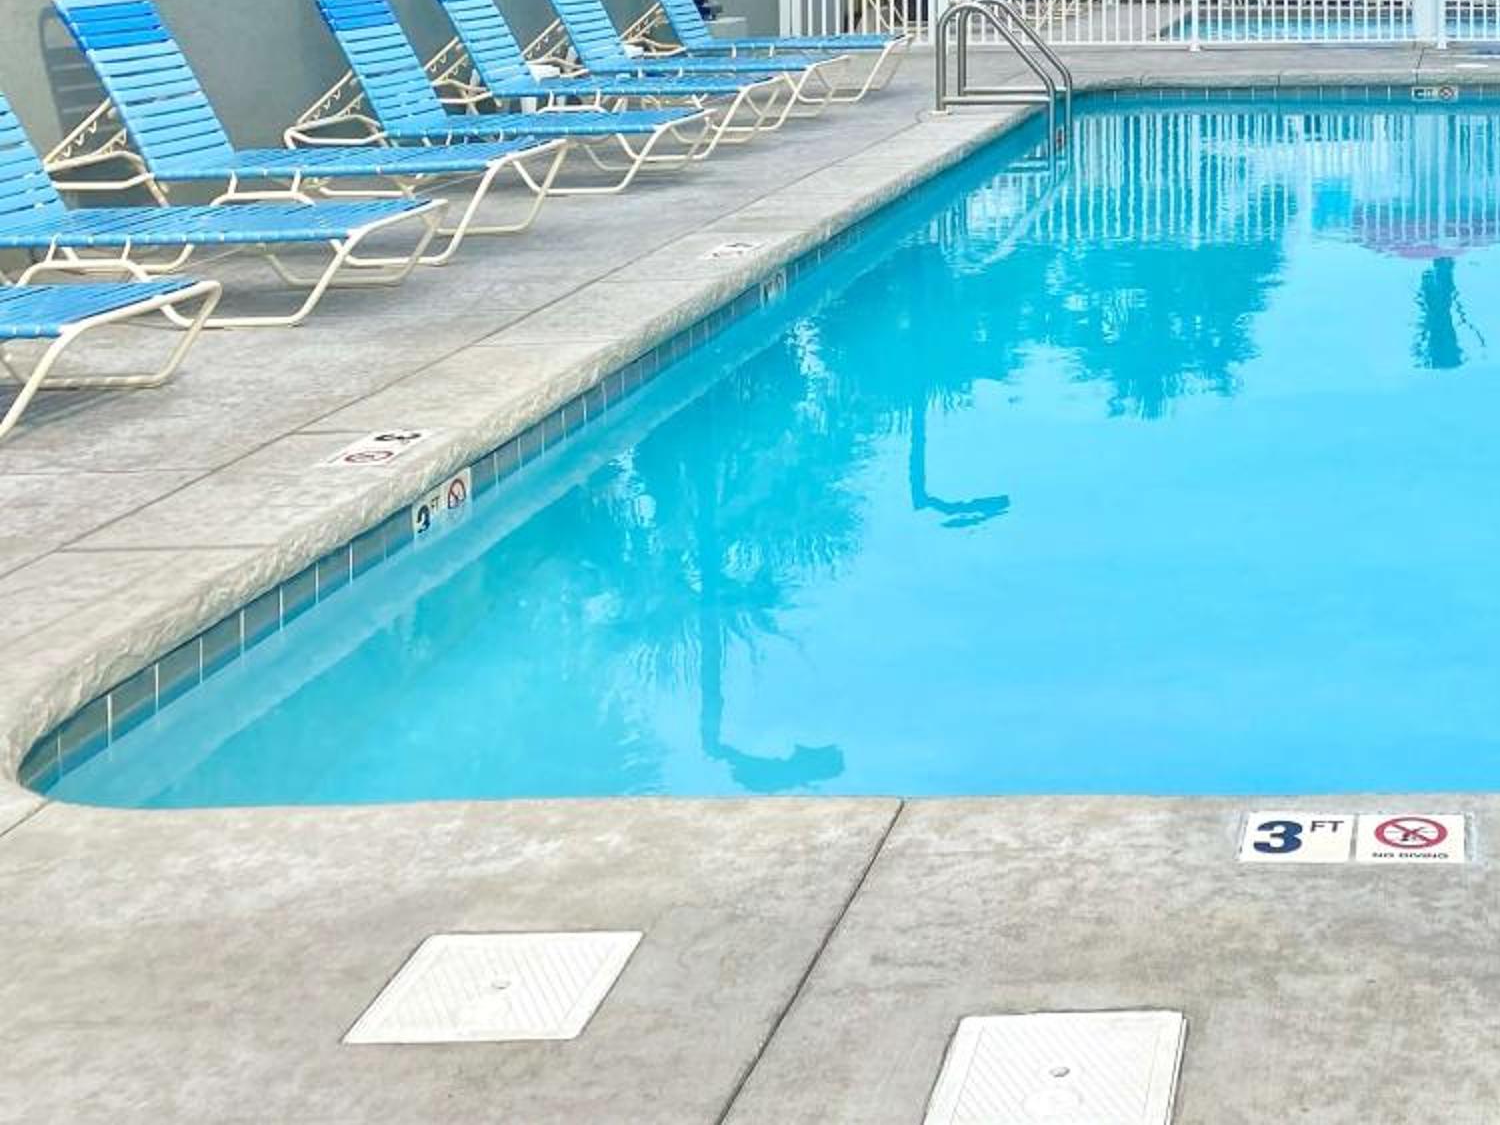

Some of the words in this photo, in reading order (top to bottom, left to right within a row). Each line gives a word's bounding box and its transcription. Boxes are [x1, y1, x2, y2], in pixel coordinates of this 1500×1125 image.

[416, 504, 431, 533] 3
[1253, 820, 1303, 854] 3
[1310, 820, 1344, 833] FT
